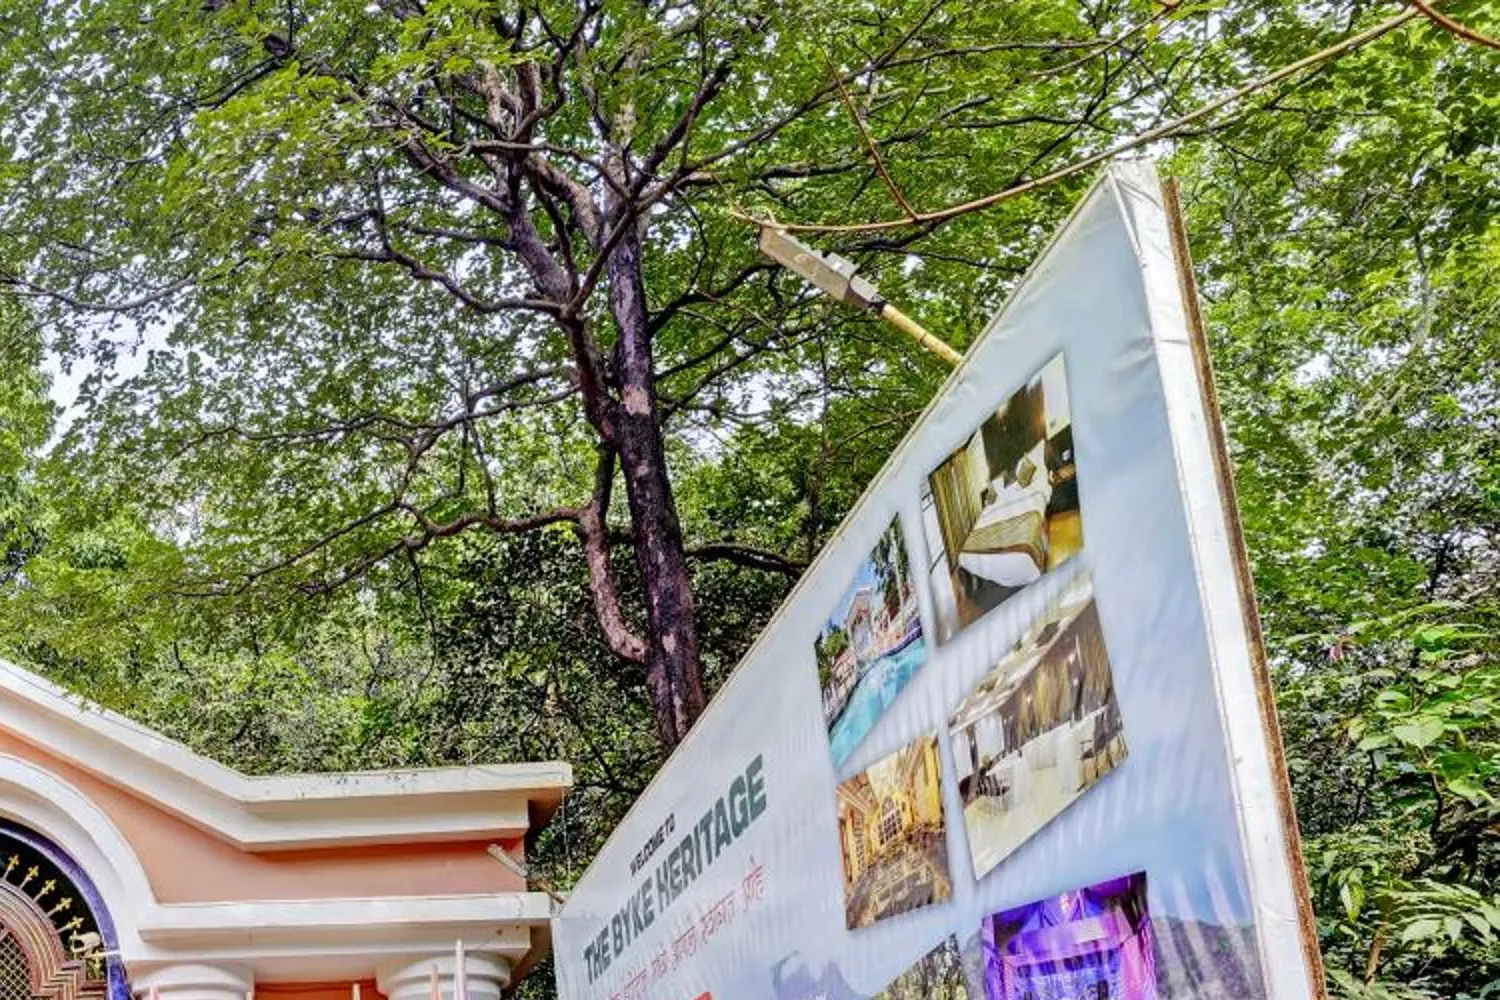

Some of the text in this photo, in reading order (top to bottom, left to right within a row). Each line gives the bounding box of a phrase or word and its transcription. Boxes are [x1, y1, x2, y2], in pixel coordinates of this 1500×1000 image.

[583, 924, 611, 984] THE
[610, 875, 656, 958] BYKE
[655, 753, 768, 912] HERITAGE
